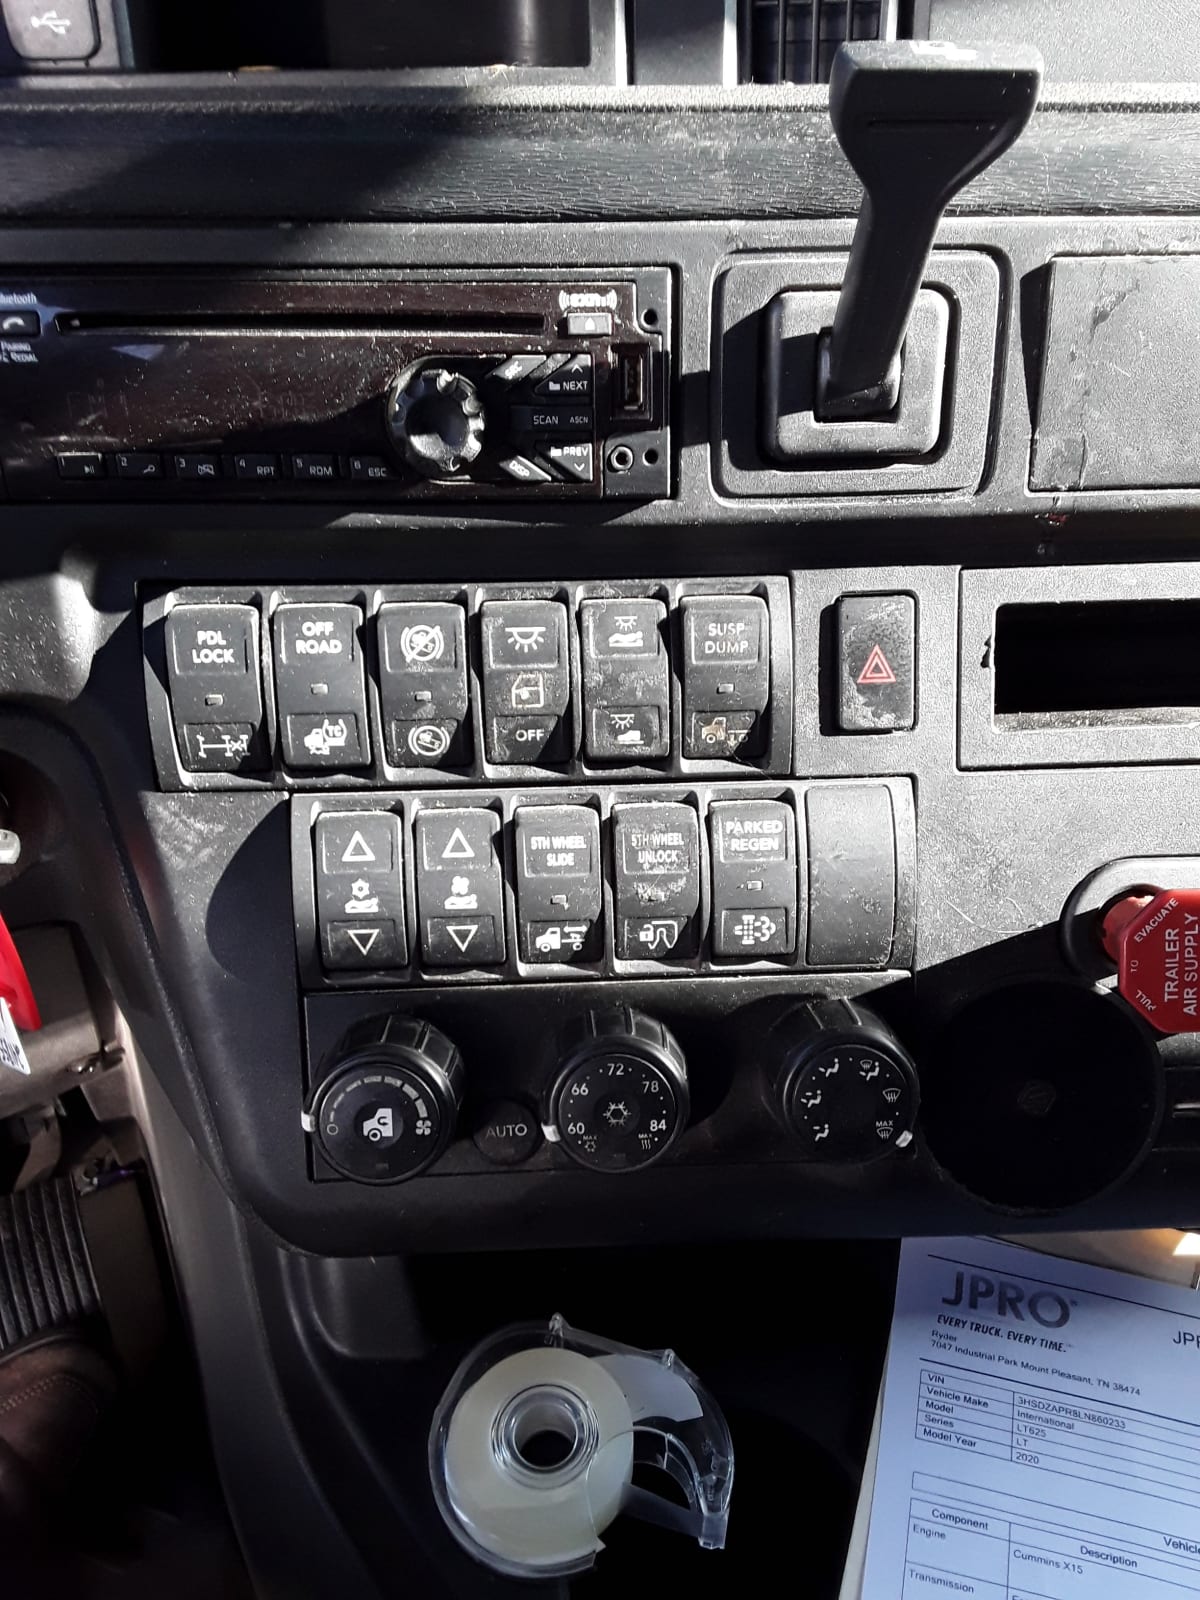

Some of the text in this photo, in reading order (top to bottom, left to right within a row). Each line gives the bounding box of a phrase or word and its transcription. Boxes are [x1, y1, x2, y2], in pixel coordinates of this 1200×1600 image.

[563, 381, 588, 391] NEXT
[533, 415, 559, 425] SCAN
[563, 446, 589, 456] PREV
[121, 456, 128, 467] 2
[179, 458, 186, 468] 3
[239, 459, 246, 468] 4
[256, 465, 275, 476] RPT
[309, 466, 333, 476] RDM
[368, 467, 387, 477] ESC
[301, 621, 335, 637] OFF
[707, 622, 746, 637] SUSP
[197, 630, 227, 645] PDL
[295, 639, 343, 655] ROAD
[704, 640, 750, 655] DUMP
[192, 648, 235, 664] LOCK
[515, 729, 545, 743] OFF
[725, 819, 783, 835] PARKED
[530, 836, 587, 850] 5TH WHEEL
[631, 832, 685, 847] 5TH WHEEL
[730, 837, 780, 852] REGEN
[546, 853, 575, 867] SLIDE
[638, 849, 679, 864] UNLOCK
[1134, 897, 1179, 943] EVACUATE
[1164, 928, 1180, 1002] TRAILER
[1183, 913, 1199, 1016] AIR SUPPLY
[1135, 989, 1156, 1012] PULL
[607, 1063, 625, 1076] 72
[571, 1083, 589, 1096] 66
[642, 1080, 659, 1093] 78
[486, 1123, 528, 1139] AUTO
[567, 1122, 585, 1135] 60
[649, 1119, 667, 1132] 84
[941, 1271, 1070, 1329] JPRO
[931, 1329, 957, 1342] Ryder
[937, 1314, 1067, 1353] EVERY TRUCK. EVERY TIME.
[930, 1340, 1141, 1396] 7047 Industrial Park Mount Pleasant, TN 38474
[927, 1373, 945, 1385] VIN
[926, 1386, 989, 1409] Vehicle Make
[925, 1400, 954, 1414] Model
[924, 1414, 955, 1428] Series
[1017, 1409, 1075, 1431] International
[923, 1427, 977, 1448] Model Year
[1016, 1423, 1047, 1438] LT625
[1016, 1435, 1029, 1447] LT
[1015, 1451, 1040, 1465] 2020
[931, 1508, 989, 1531] Component
[912, 1523, 946, 1540] Engine
[1013, 1549, 1084, 1575] Cummins X15
[1079, 1545, 1138, 1568] Description
[909, 1569, 975, 1594] Transmission
